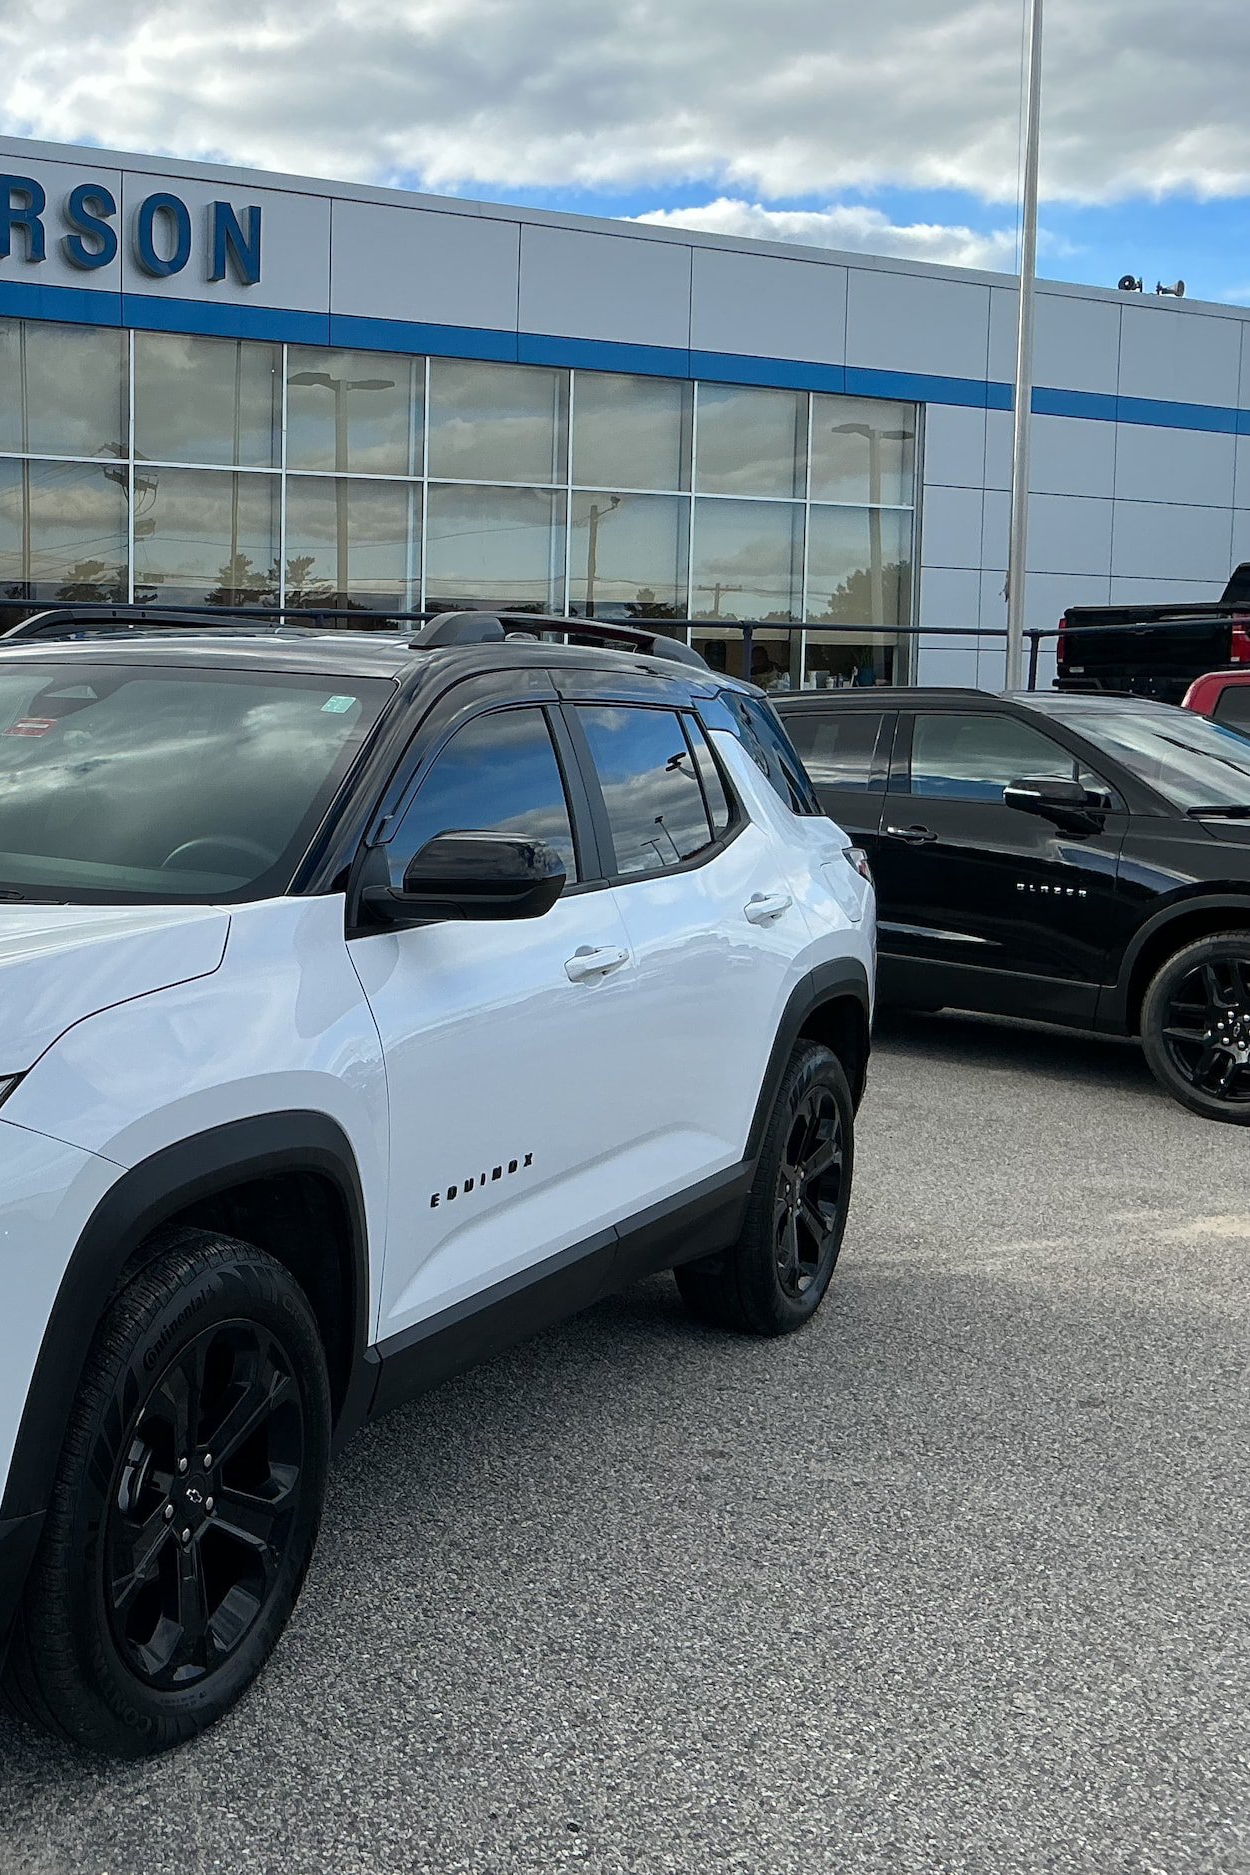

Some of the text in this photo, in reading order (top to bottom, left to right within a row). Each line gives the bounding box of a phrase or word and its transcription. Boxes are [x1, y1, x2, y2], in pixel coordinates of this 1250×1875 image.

[1016, 883, 1087, 898] BLAZER
[430, 1152, 533, 1208] EQUINOX
[142, 1288, 212, 1371] Continental
